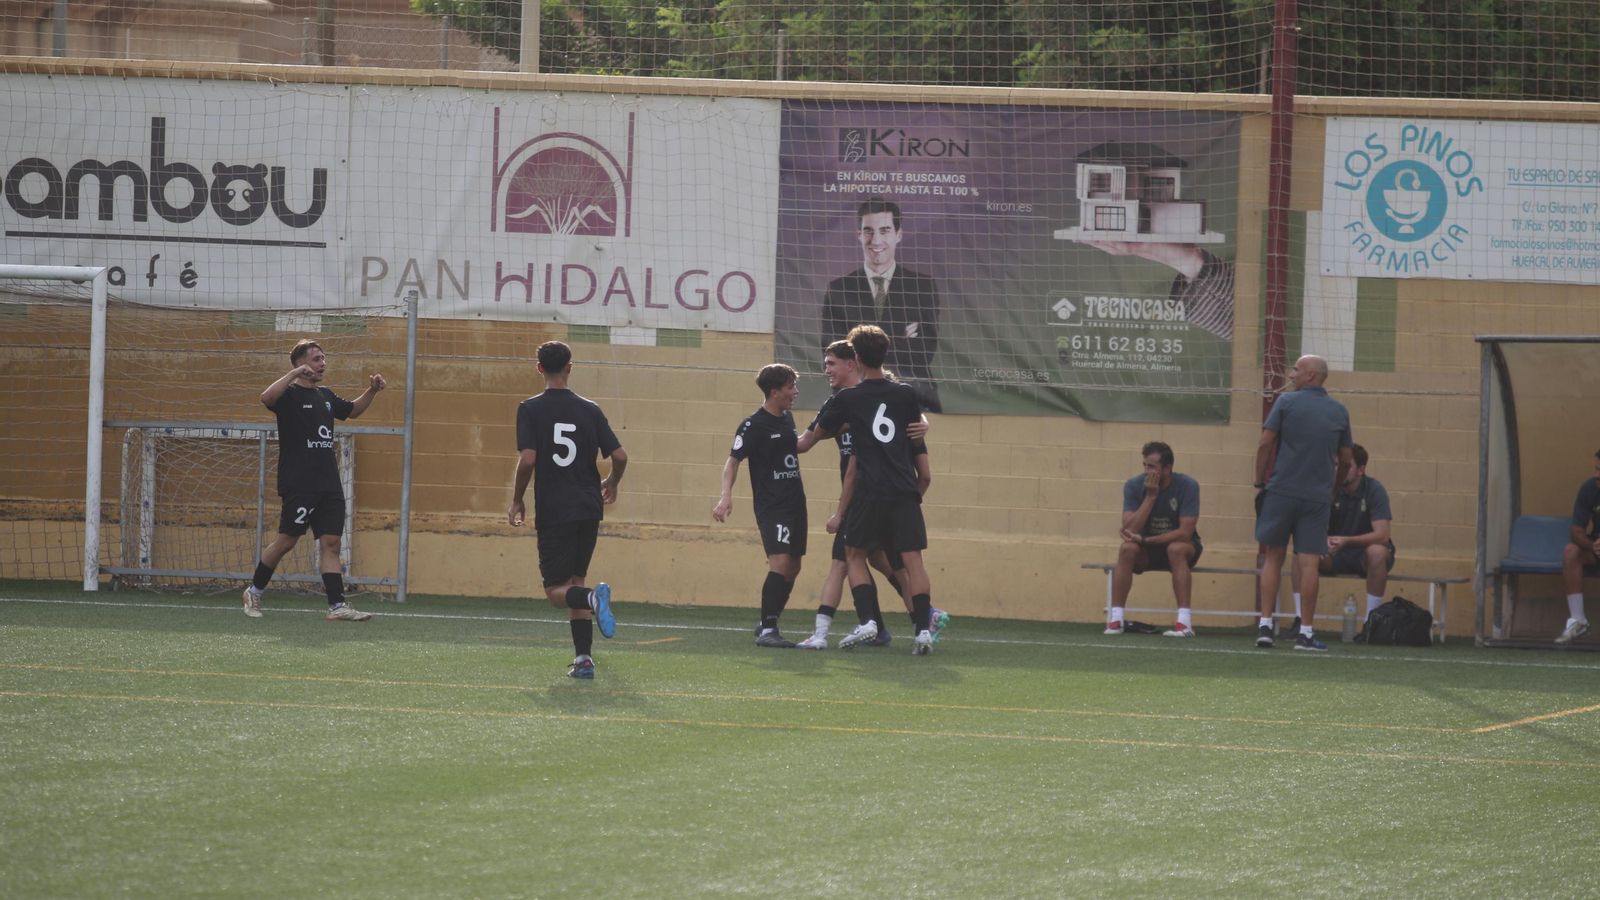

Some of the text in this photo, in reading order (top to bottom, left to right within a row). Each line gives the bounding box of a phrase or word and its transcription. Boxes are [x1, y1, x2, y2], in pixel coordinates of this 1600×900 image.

[1334, 124, 1483, 197] LOS PINOS
[0, 117, 328, 228] ambou
[837, 171, 851, 181] EN
[890, 172, 902, 182] TE
[905, 173, 966, 184] BUSCAMOS
[1507, 168, 1520, 181] TU
[1522, 168, 1566, 182] ESPACIO
[1568, 169, 1582, 183] DE
[823, 183, 980, 197] LA HIPOTECA HASTA EL 100 %
[1548, 219, 1566, 232] 950
[1568, 220, 1587, 233] 300
[1344, 220, 1469, 273] FARMACIA
[1552, 256, 1565, 268] DE
[360, 256, 757, 313] PAN HIDALGO
[1084, 296, 1186, 321] TECNOCASA
[1072, 335, 1183, 354] 611 62 83 35
[1104, 361, 1115, 369] de
[872, 403, 896, 444] 6
[552, 422, 577, 467] 5
[776, 524, 791, 544] 12
